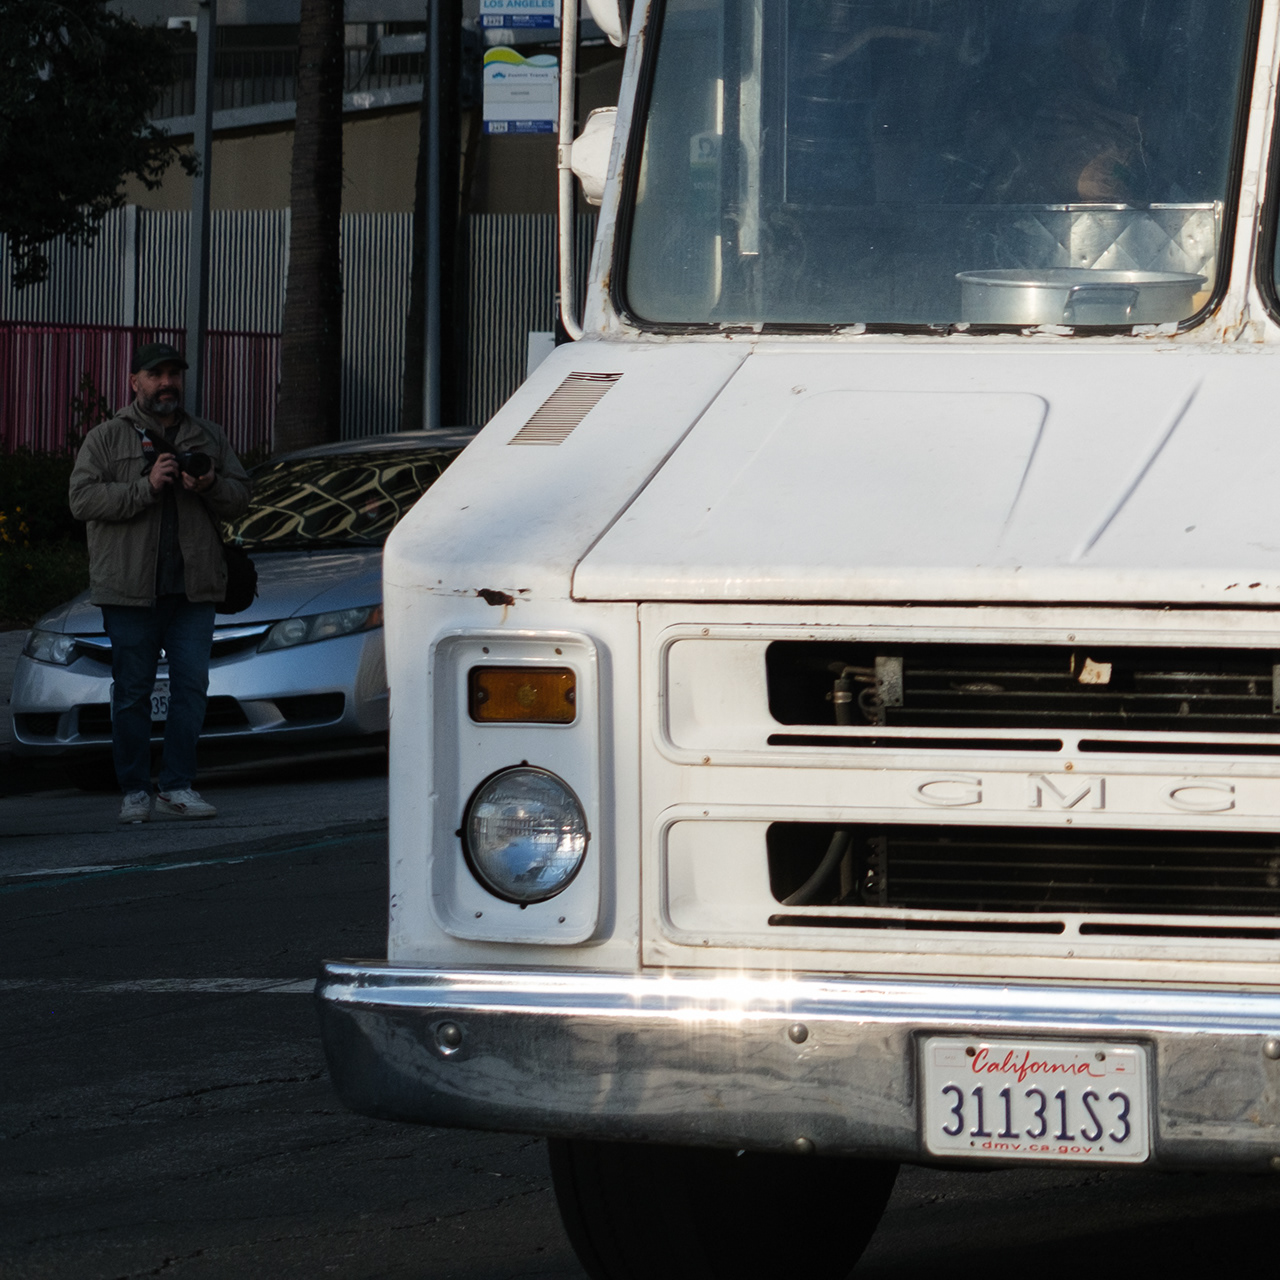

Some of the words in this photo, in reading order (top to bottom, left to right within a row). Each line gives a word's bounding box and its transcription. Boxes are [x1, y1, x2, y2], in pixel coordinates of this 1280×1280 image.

[484, 0, 503, 8] LOS
[507, 0, 554, 8] ANGELES
[908, 772, 1236, 813] GMC
[972, 1048, 1106, 1082] California
[941, 1085, 1131, 1143] 31131S3
[982, 1140, 1093, 1154] dmv.ca.gov
